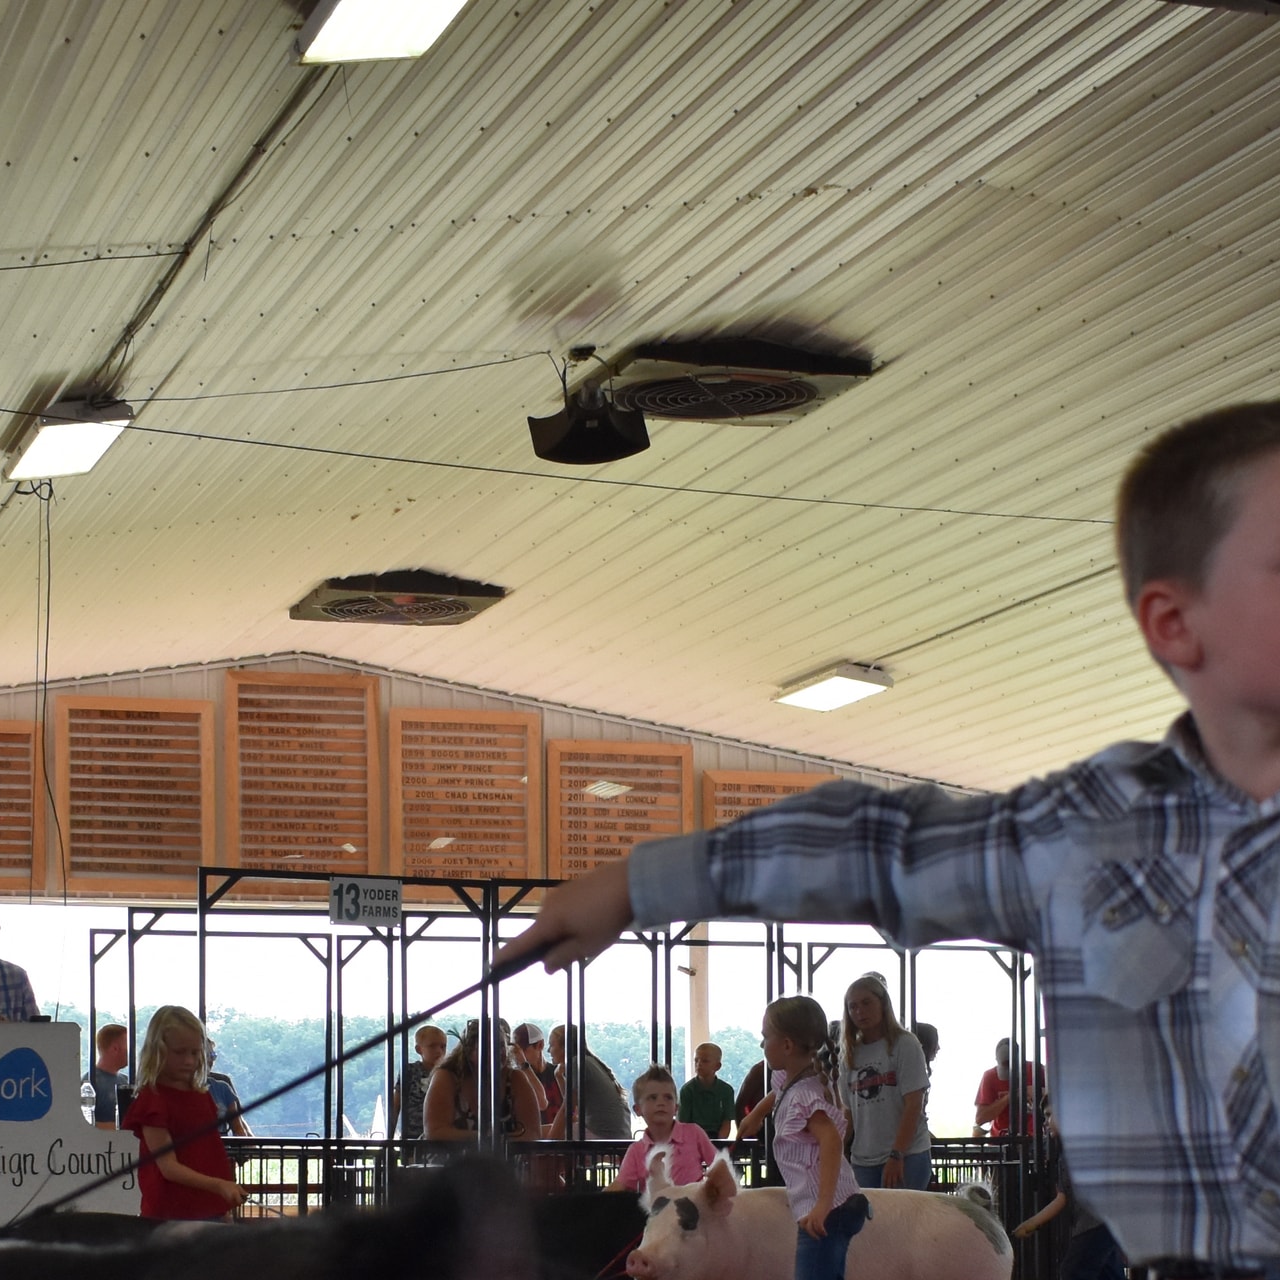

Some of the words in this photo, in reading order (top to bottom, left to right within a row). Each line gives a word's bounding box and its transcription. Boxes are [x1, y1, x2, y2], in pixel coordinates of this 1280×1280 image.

[464, 751, 508, 760] BROTHERS
[463, 765, 492, 773] PRINCE
[722, 783, 741, 791] 2018
[594, 808, 610, 816] CODY
[618, 809, 648, 817] LENSMAN
[594, 822, 618, 830] MAGGIE
[568, 834, 587, 842] 2014
[568, 847, 588, 855] 2015
[594, 848, 621, 856] MIRANDA
[568, 860, 587, 868] 2016
[362, 888, 399, 902] YODER
[332, 882, 360, 922] 13
[362, 905, 399, 919] FARMS
[47, 1138, 136, 1191] County
